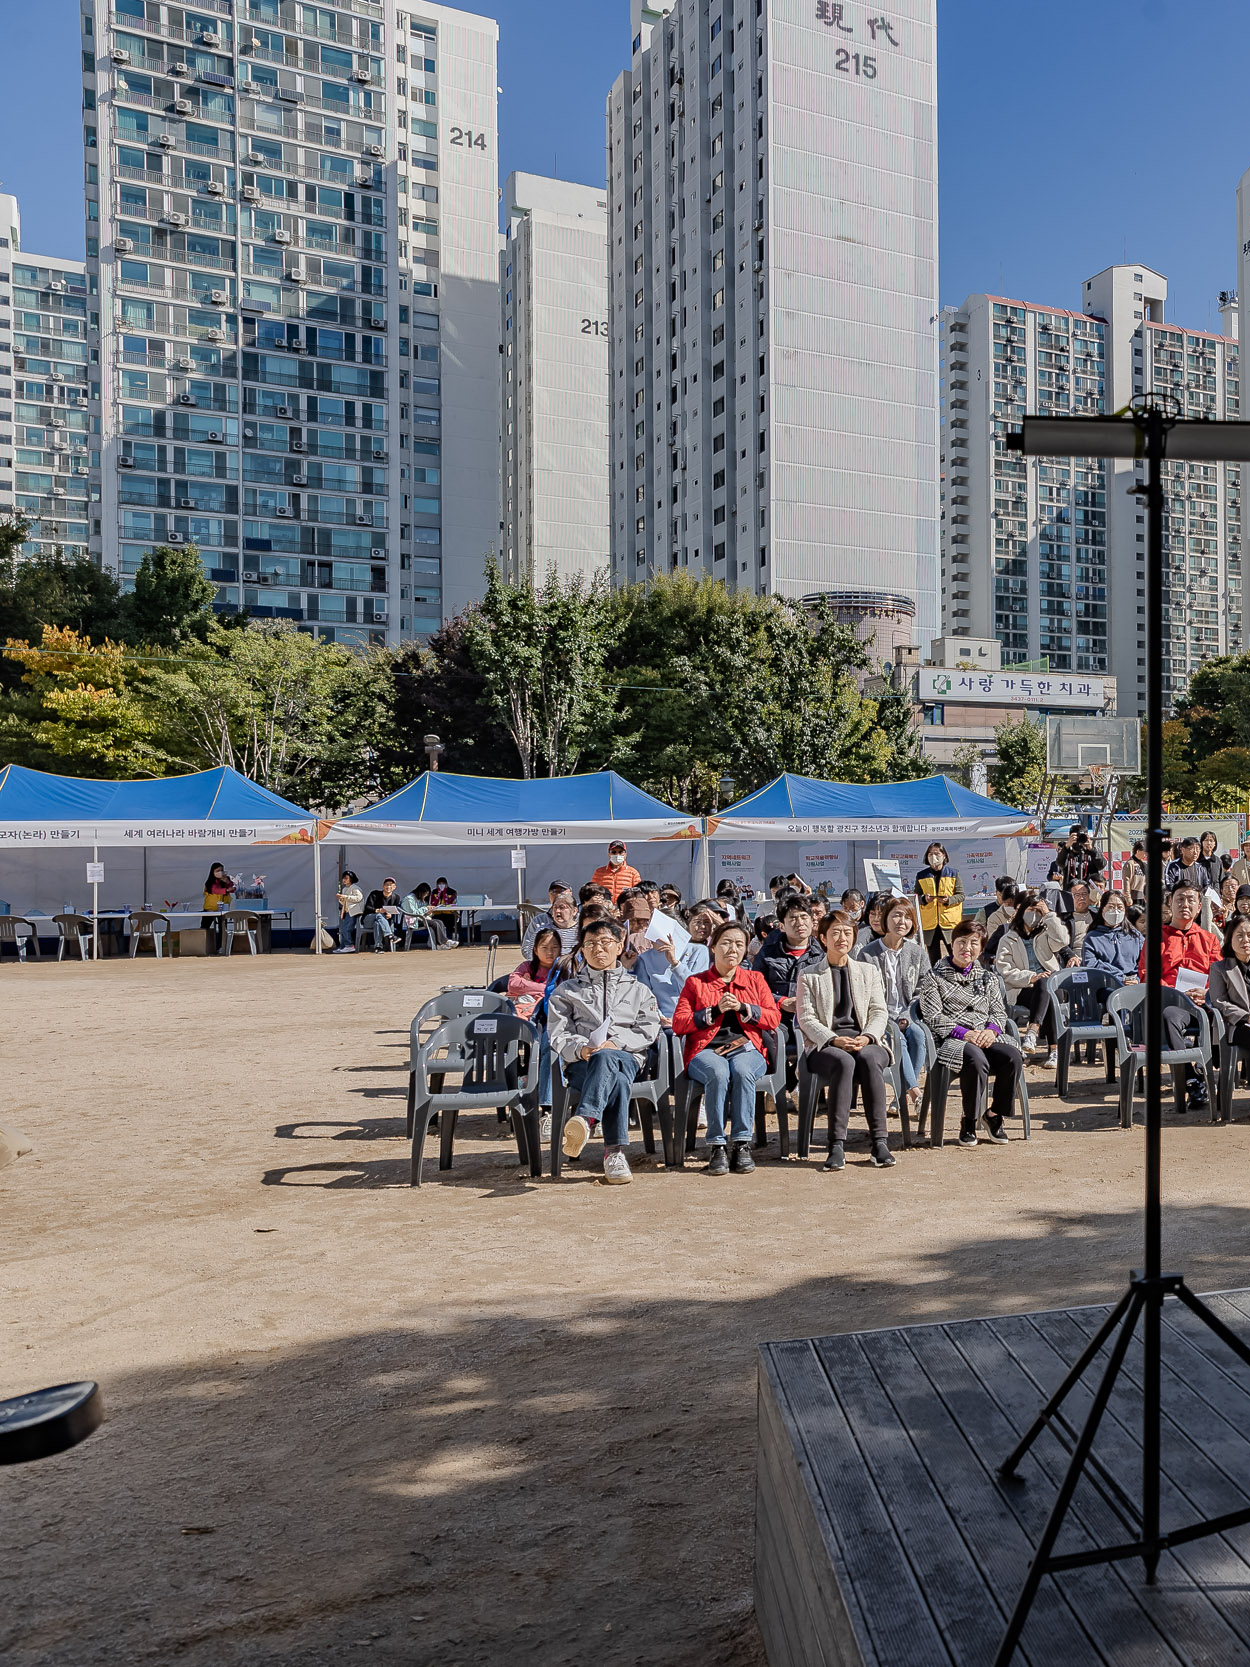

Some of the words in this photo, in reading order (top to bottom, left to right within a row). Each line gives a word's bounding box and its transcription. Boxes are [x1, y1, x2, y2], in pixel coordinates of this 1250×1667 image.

[835, 48, 877, 79] 215
[450, 127, 487, 150] 214
[581, 318, 608, 337] 213
[976, 369, 982, 381] 3
[958, 675, 994, 693] 사랑
[1000, 678, 1052, 696] 가득한
[1059, 682, 1092, 697] 치과
[50, 829, 80, 839] 만들기
[123, 829, 143, 838] 세계
[146, 829, 185, 838] 여러나라
[188, 829, 226, 838] 바람개비
[228, 828, 257, 838] 만들기
[467, 827, 484, 836] 미니
[486, 827, 503, 836] 세계
[505, 827, 539, 836] 여행가방
[541, 827, 566, 836] 만들기
[787, 824, 810, 833] 오늘이
[812, 824, 835, 833] 행복할
[836, 824, 859, 833] 광진구
[860, 824, 890, 833] 청소년과
[892, 824, 928, 833] 함께합니다
